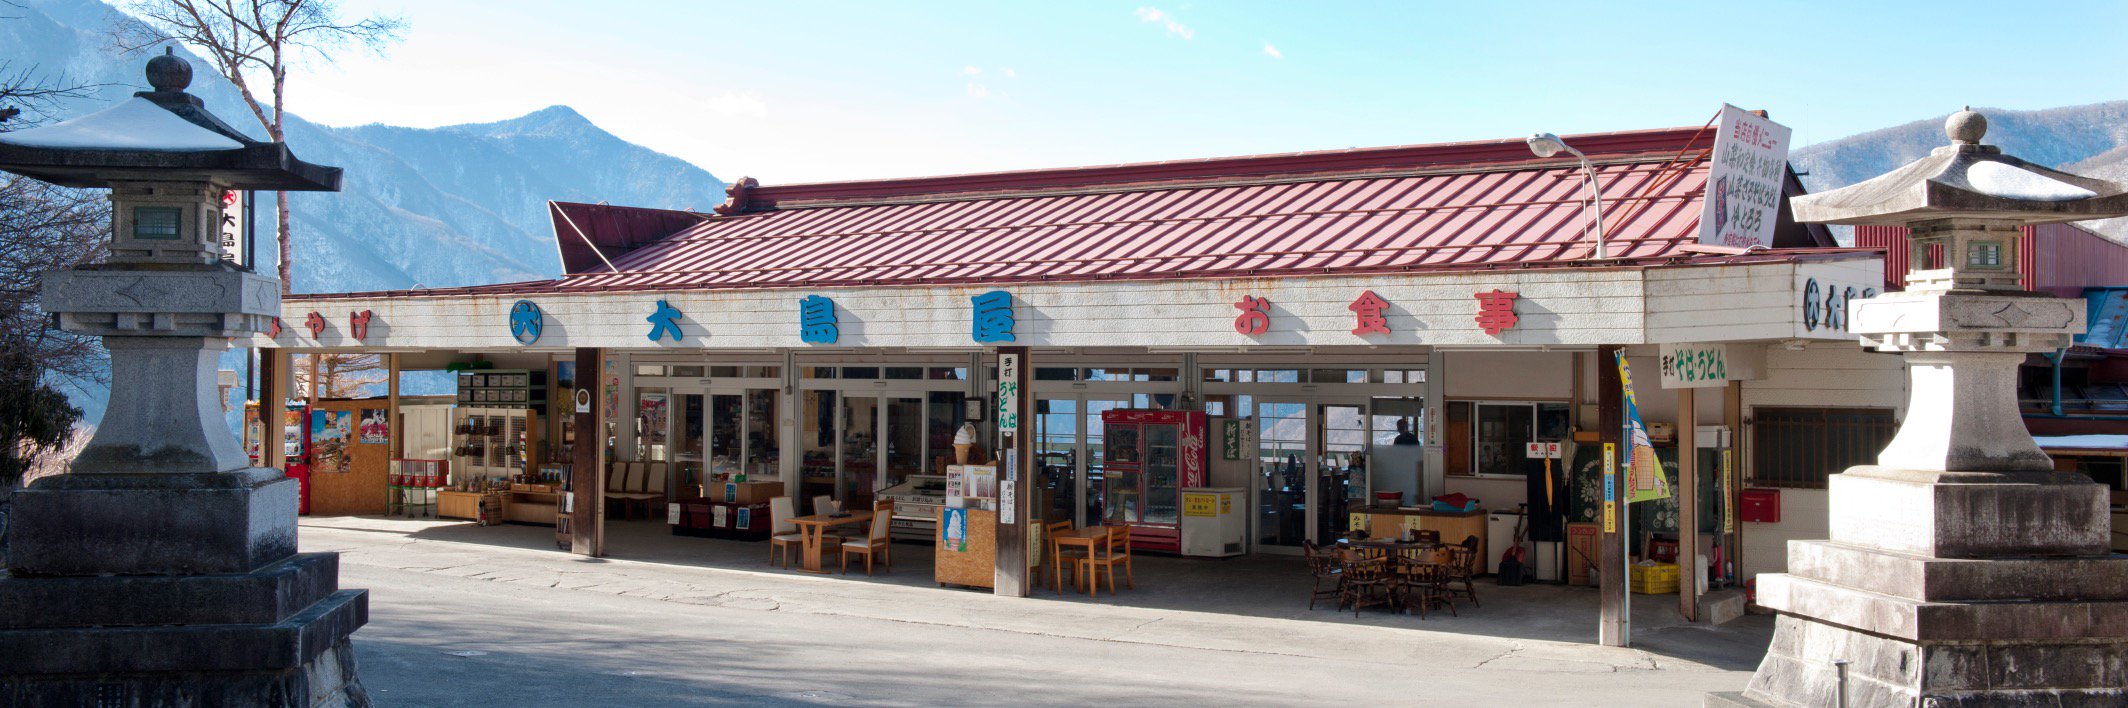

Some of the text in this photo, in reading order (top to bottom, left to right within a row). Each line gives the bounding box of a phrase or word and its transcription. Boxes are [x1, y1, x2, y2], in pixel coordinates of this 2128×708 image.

[1234, 289, 1518, 335] お食事
[999, 381, 1008, 428] うどん
